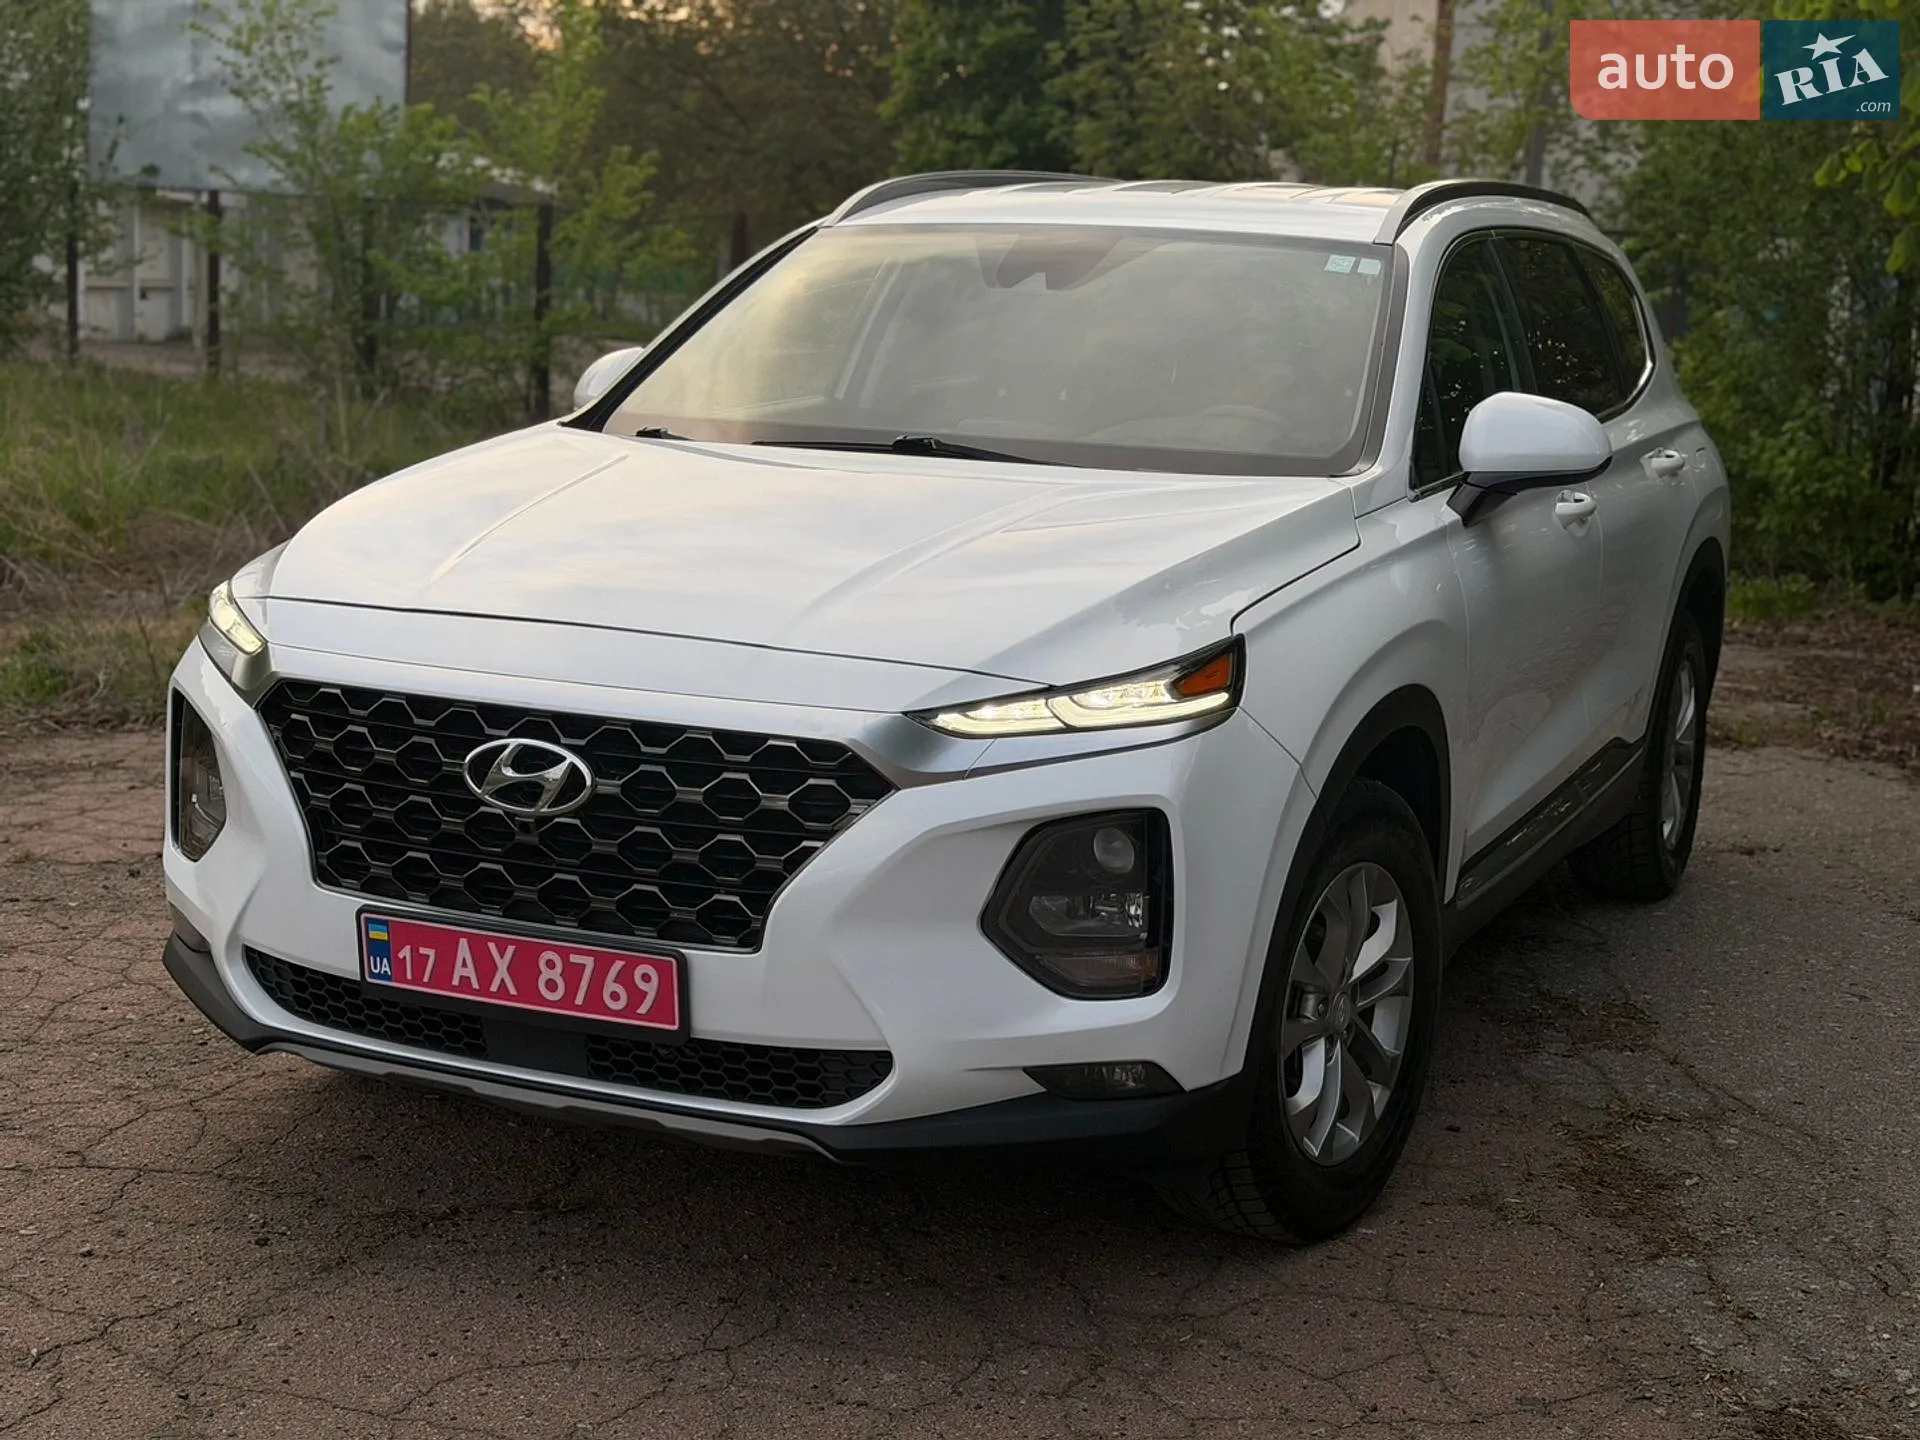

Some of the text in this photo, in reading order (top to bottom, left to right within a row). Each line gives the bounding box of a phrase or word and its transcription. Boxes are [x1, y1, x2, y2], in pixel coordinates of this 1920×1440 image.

[369, 955, 391, 976] UA
[397, 938, 660, 1015] 17 AX 8769
